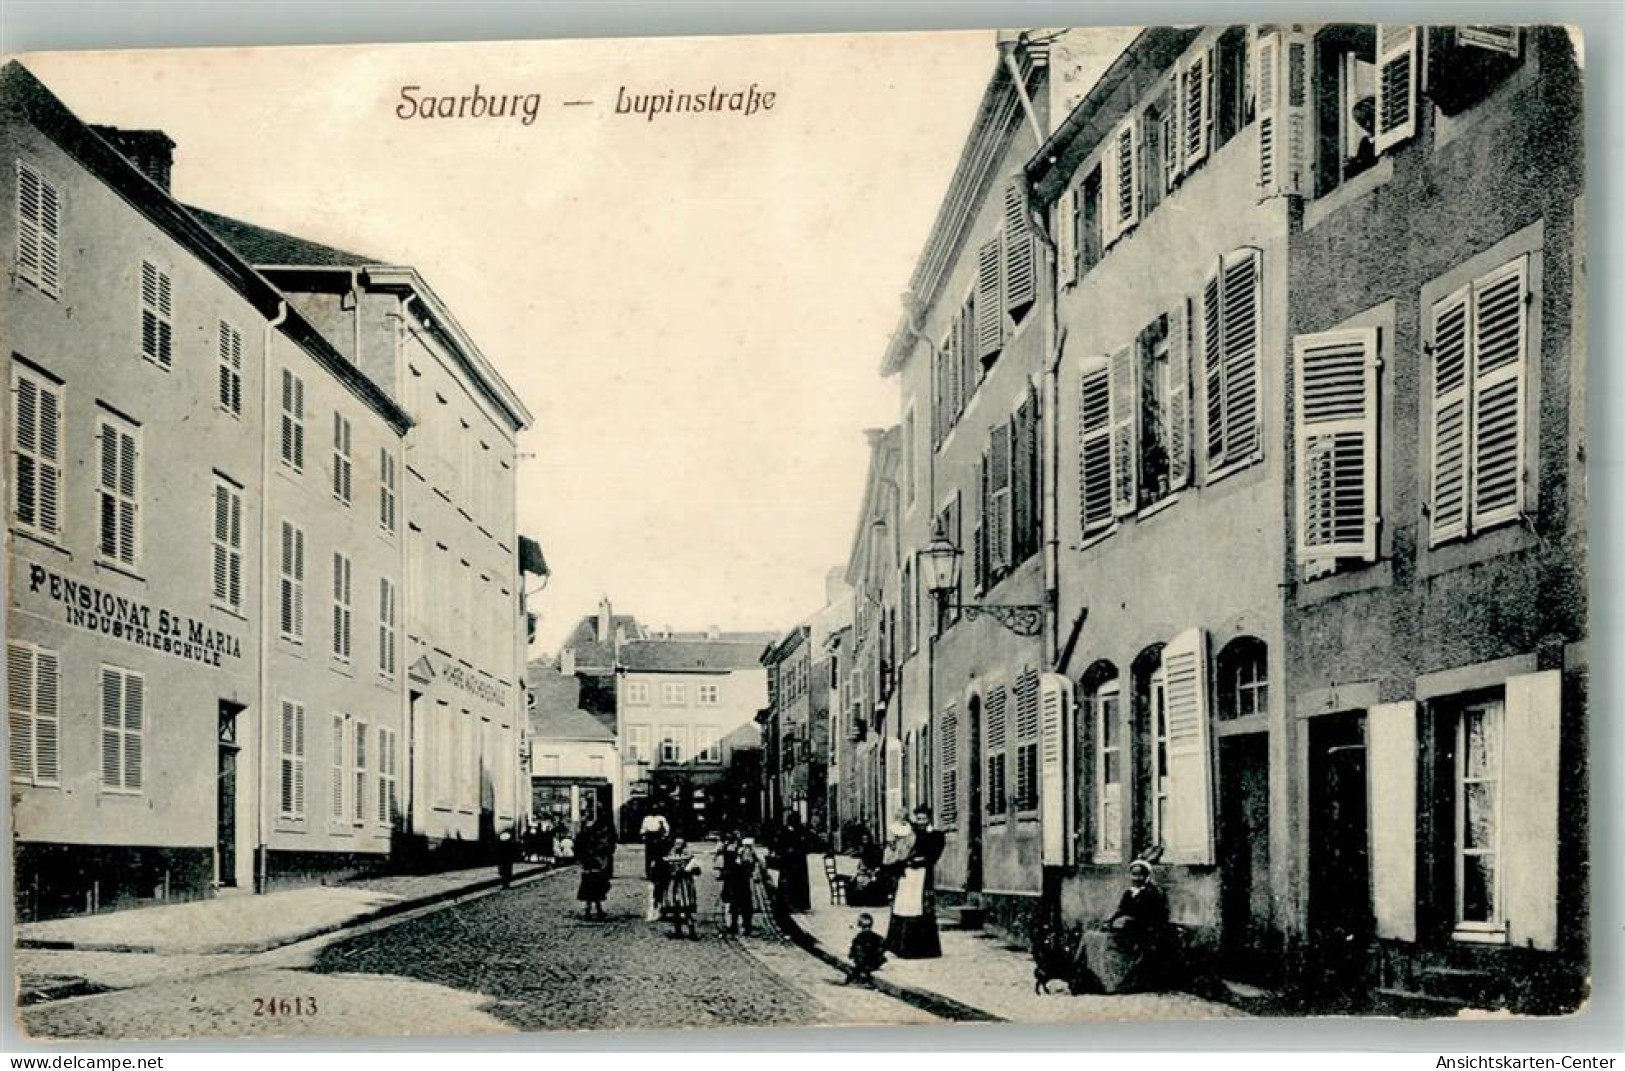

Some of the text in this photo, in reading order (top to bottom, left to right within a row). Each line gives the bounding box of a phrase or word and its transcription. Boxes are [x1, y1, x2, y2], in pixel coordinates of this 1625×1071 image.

[29, 563, 152, 630] PENSIONAT
[188, 618, 242, 659] MARIA
[65, 604, 222, 668] INDUSTRIESCHULE
